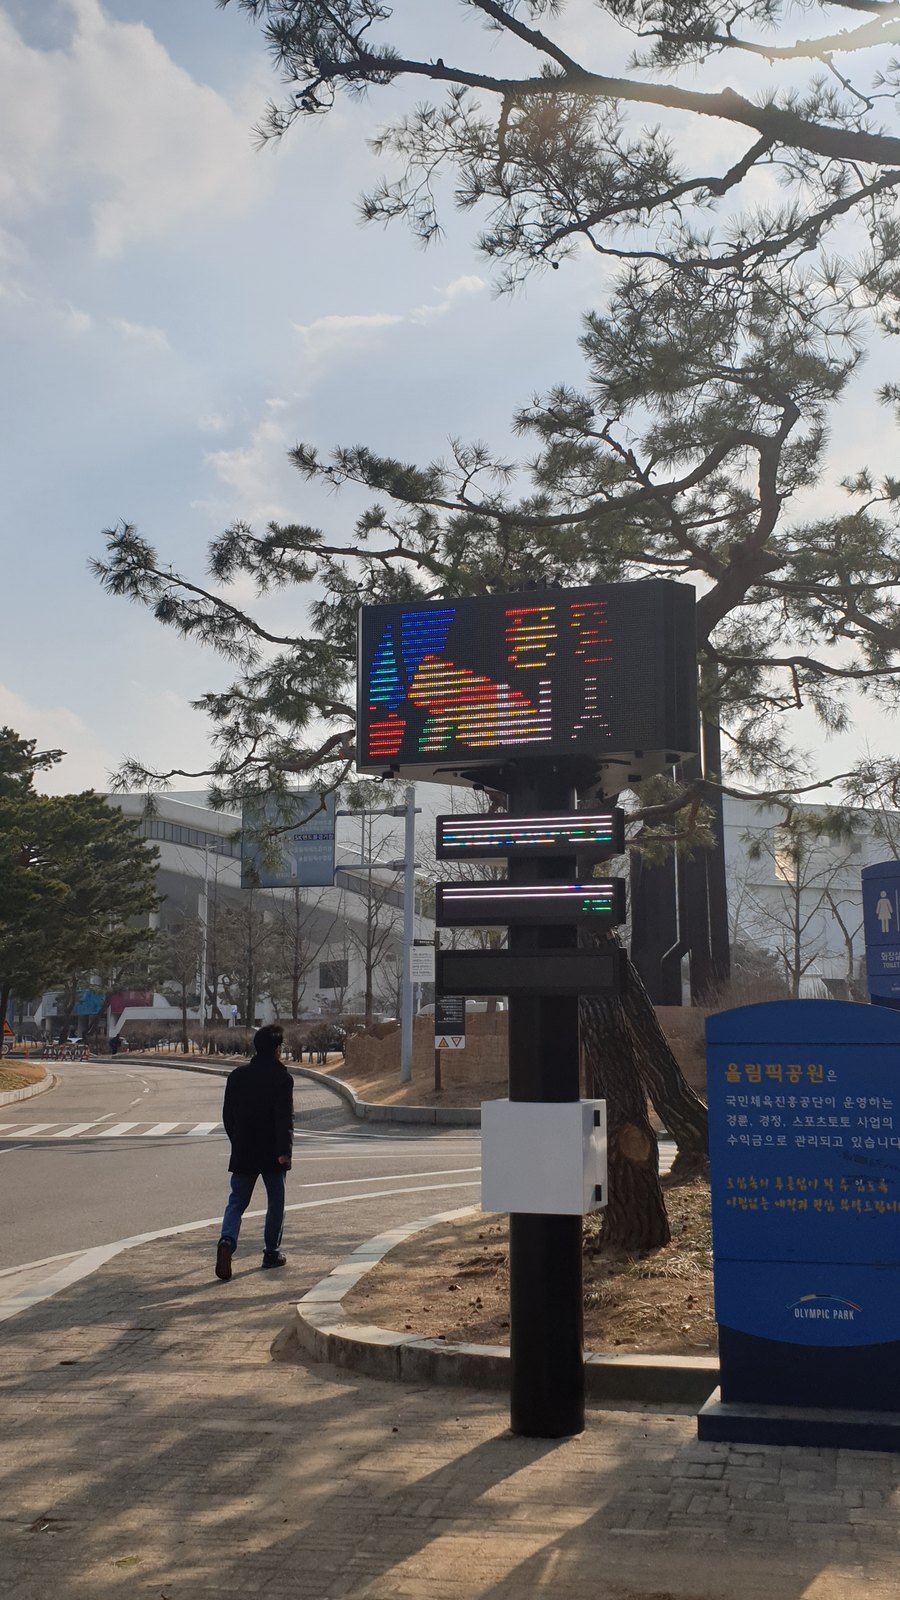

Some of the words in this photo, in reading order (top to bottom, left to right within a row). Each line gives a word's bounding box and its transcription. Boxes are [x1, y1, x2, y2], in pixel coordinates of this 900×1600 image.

[725, 1095, 836, 1108] 국민체육진흥공단이
[843, 1096, 894, 1109] 운영하는
[726, 1114, 753, 1127] 경륜,
[759, 1114, 787, 1128] 경정,
[792, 1116, 851, 1128] 스포츠토토
[857, 1116, 893, 1129] 사업의
[727, 1134, 788, 1147] 수익금으로
[794, 1135, 844, 1148] 관리되고
[851, 1136, 900, 1149] 있습니다
[794, 1308, 830, 1319] OLYMPIC
[833, 1309, 854, 1320] PARK
